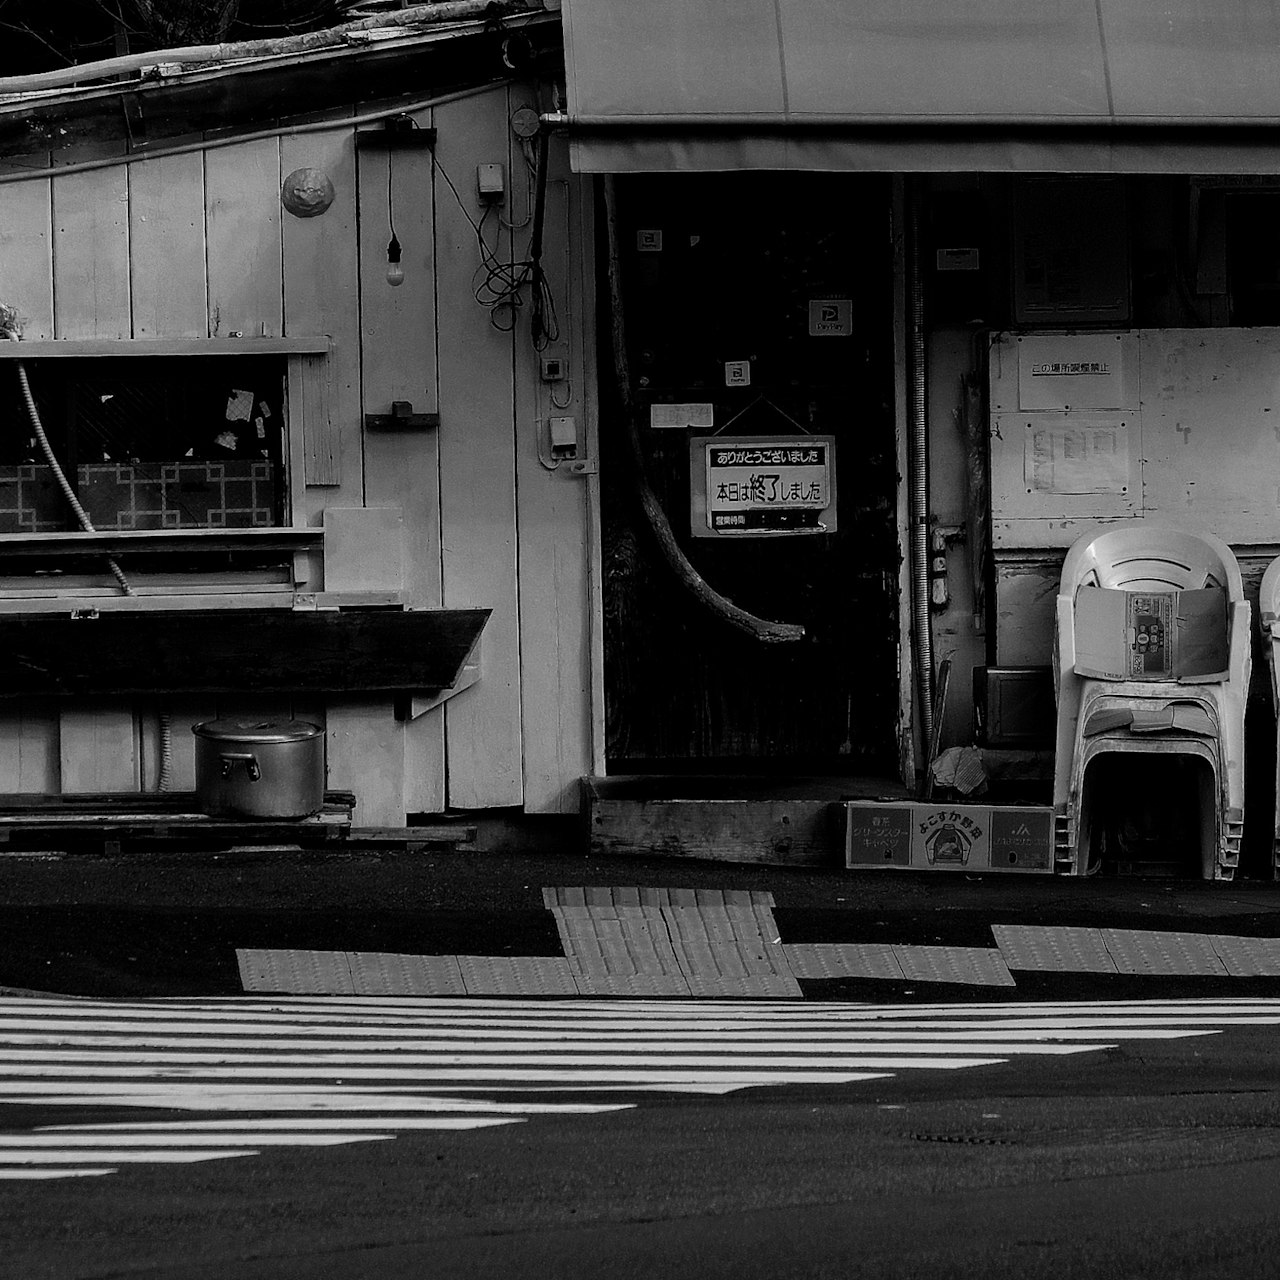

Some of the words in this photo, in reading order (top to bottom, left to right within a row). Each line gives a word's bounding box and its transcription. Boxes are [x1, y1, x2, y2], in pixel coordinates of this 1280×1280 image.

[717, 449, 819, 465] ありがとうございました
[716, 473, 821, 503] 本日は終了しました
[919, 810, 983, 841] よこすか野菜
